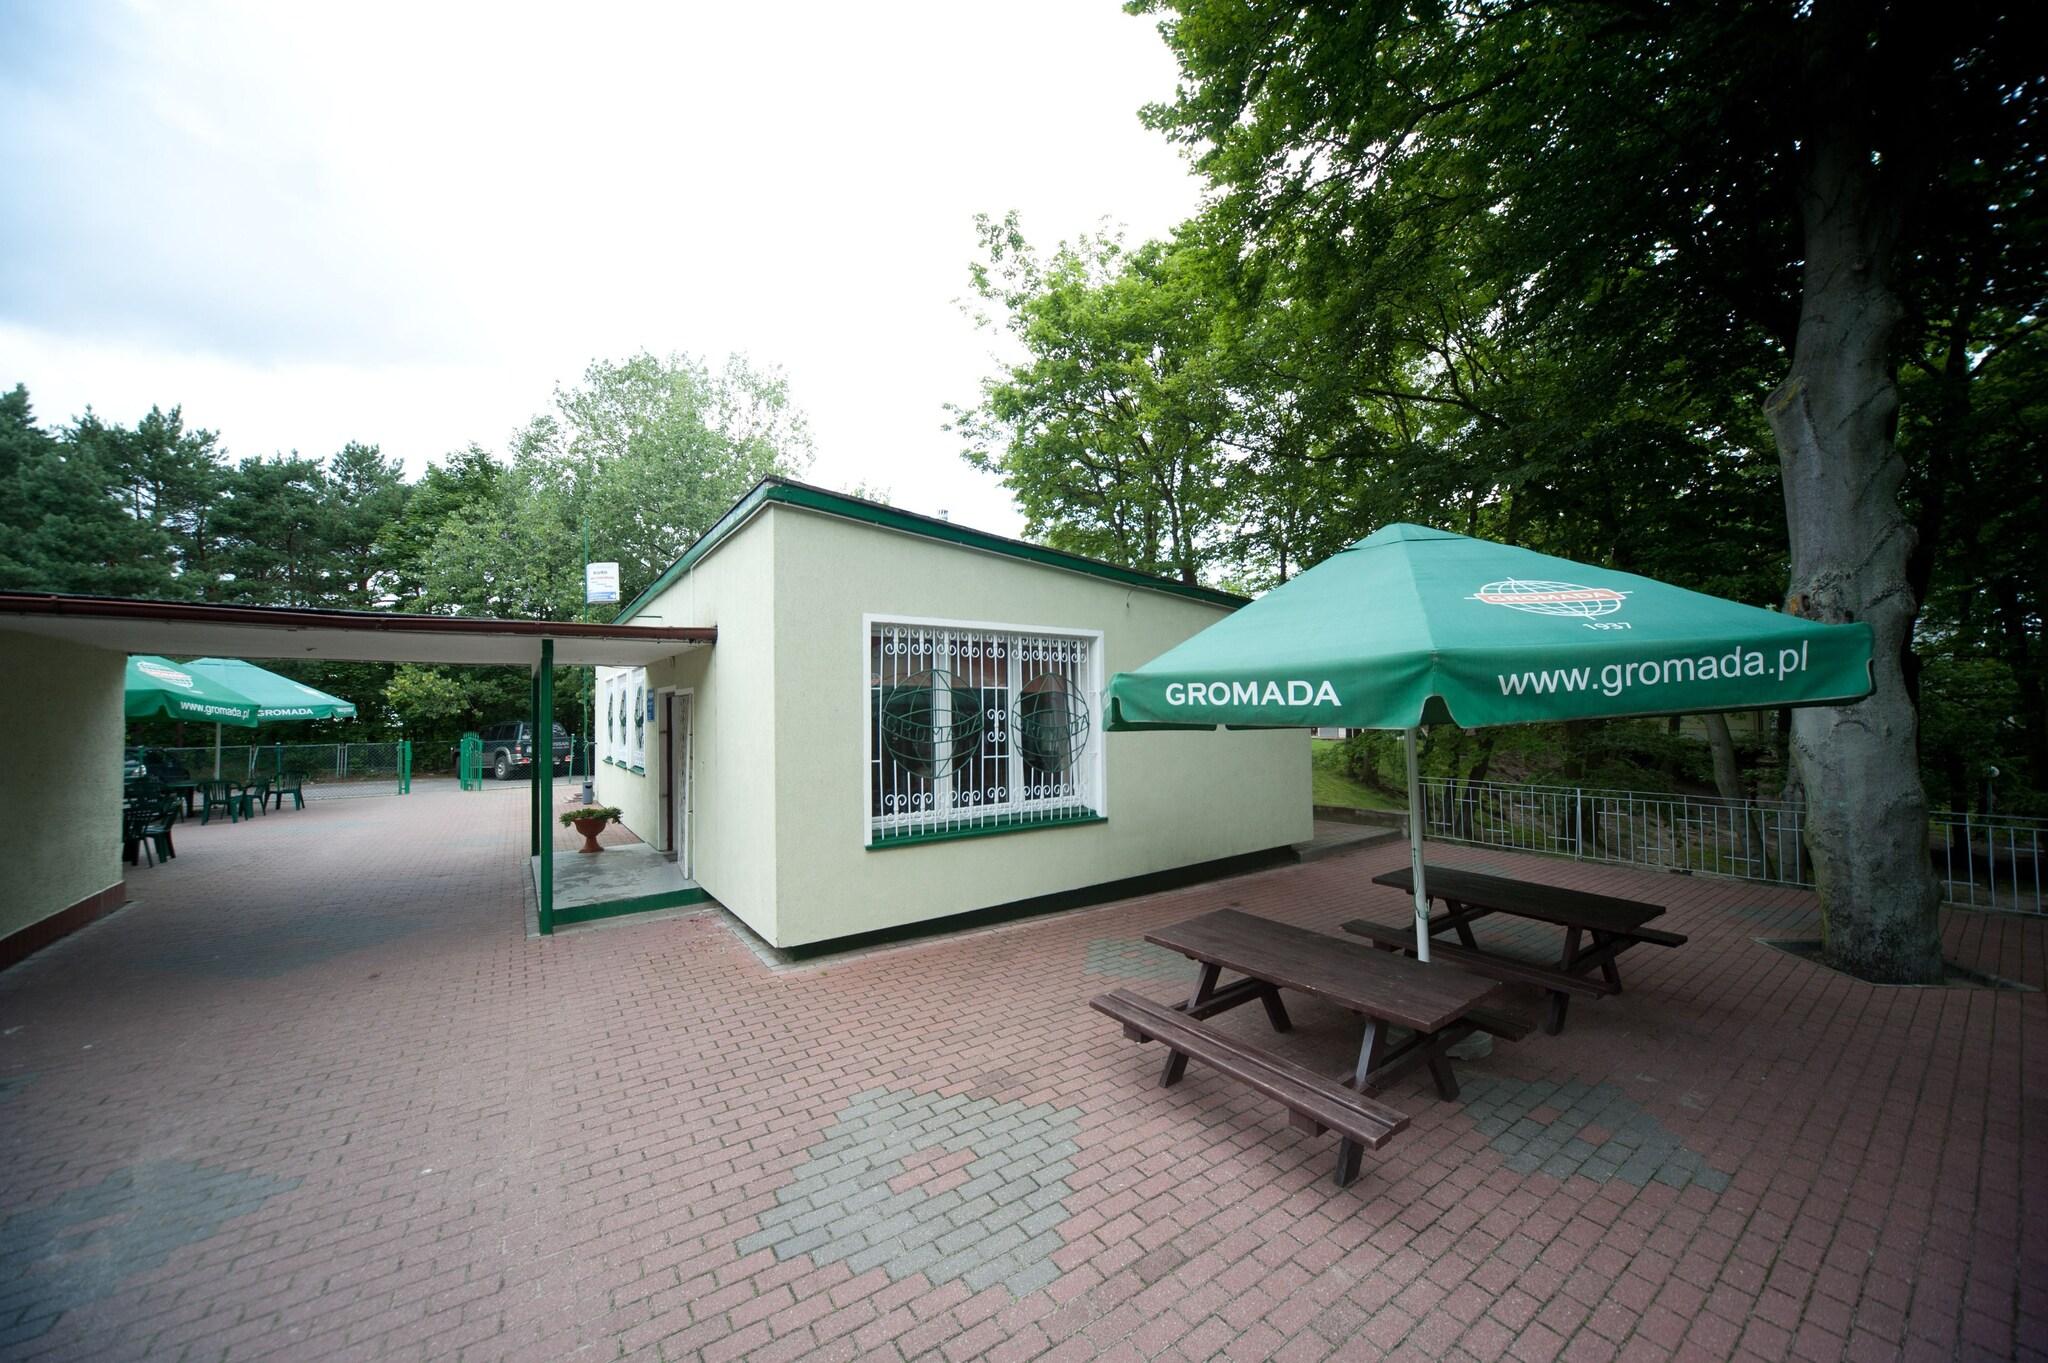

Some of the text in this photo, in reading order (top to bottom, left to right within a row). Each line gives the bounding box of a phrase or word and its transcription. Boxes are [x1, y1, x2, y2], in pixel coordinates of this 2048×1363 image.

[1582, 621, 1632, 630] 1937
[1498, 640, 1808, 697] www.gromada.pl
[1165, 680, 1342, 707] GROMADA
[180, 701, 250, 720] www.gromada.pl
